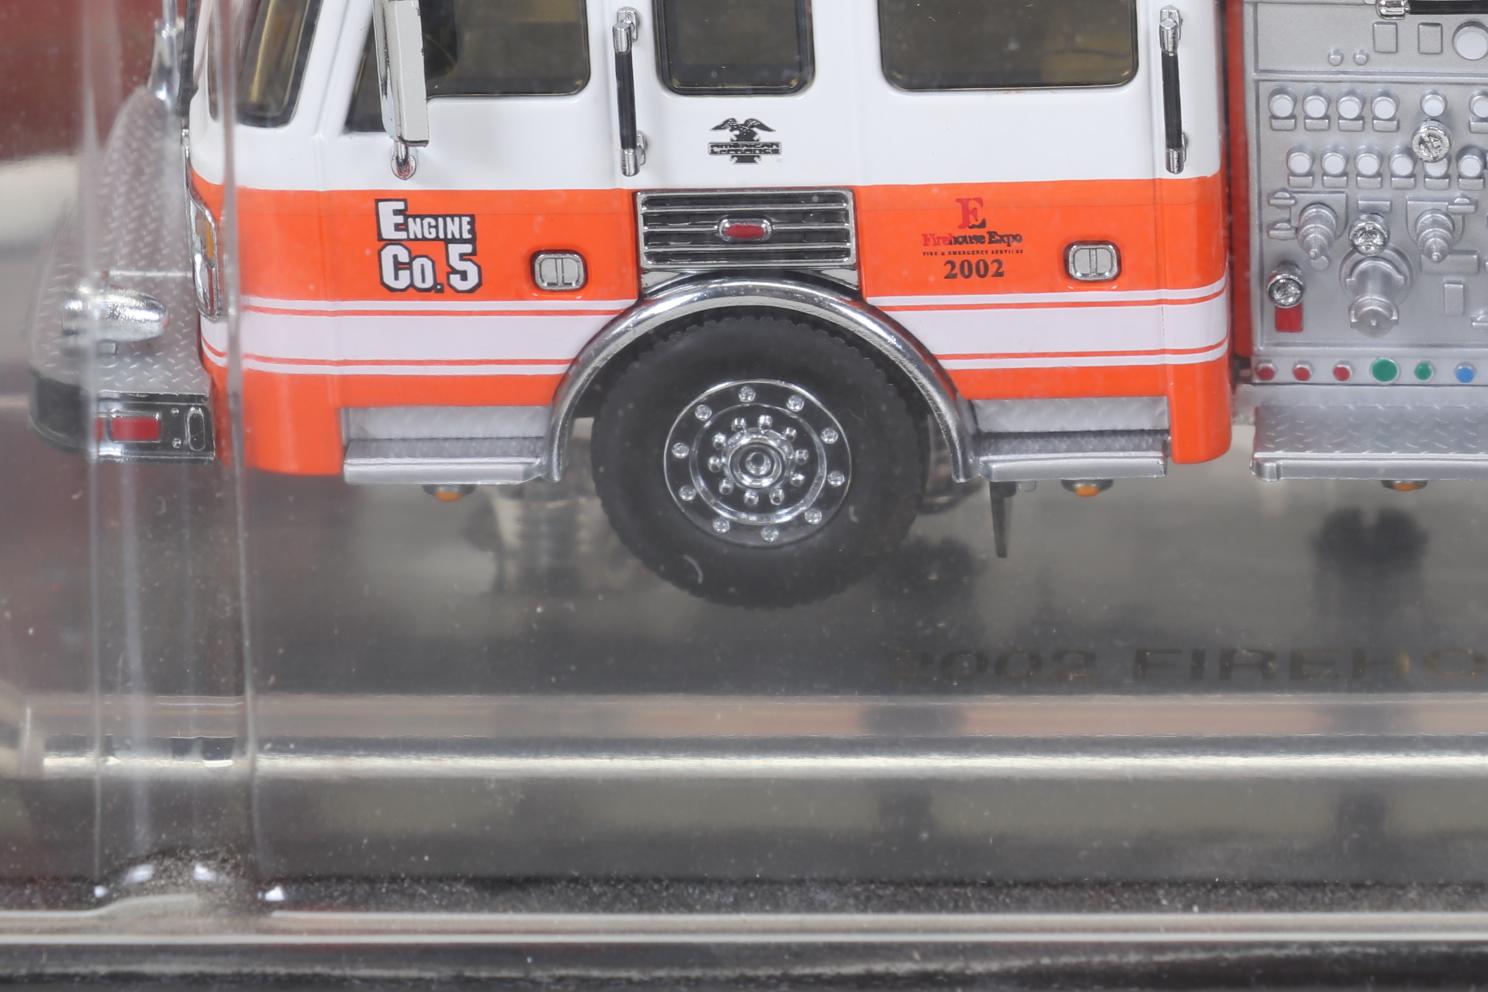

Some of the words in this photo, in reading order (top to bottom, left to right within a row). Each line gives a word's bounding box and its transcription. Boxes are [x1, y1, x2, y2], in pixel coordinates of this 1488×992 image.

[955, 197, 987, 229] E
[921, 233, 986, 247] Firehouse
[986, 230, 1023, 247] Expo
[445, 241, 483, 293] 5
[943, 258, 1005, 279] 2002
